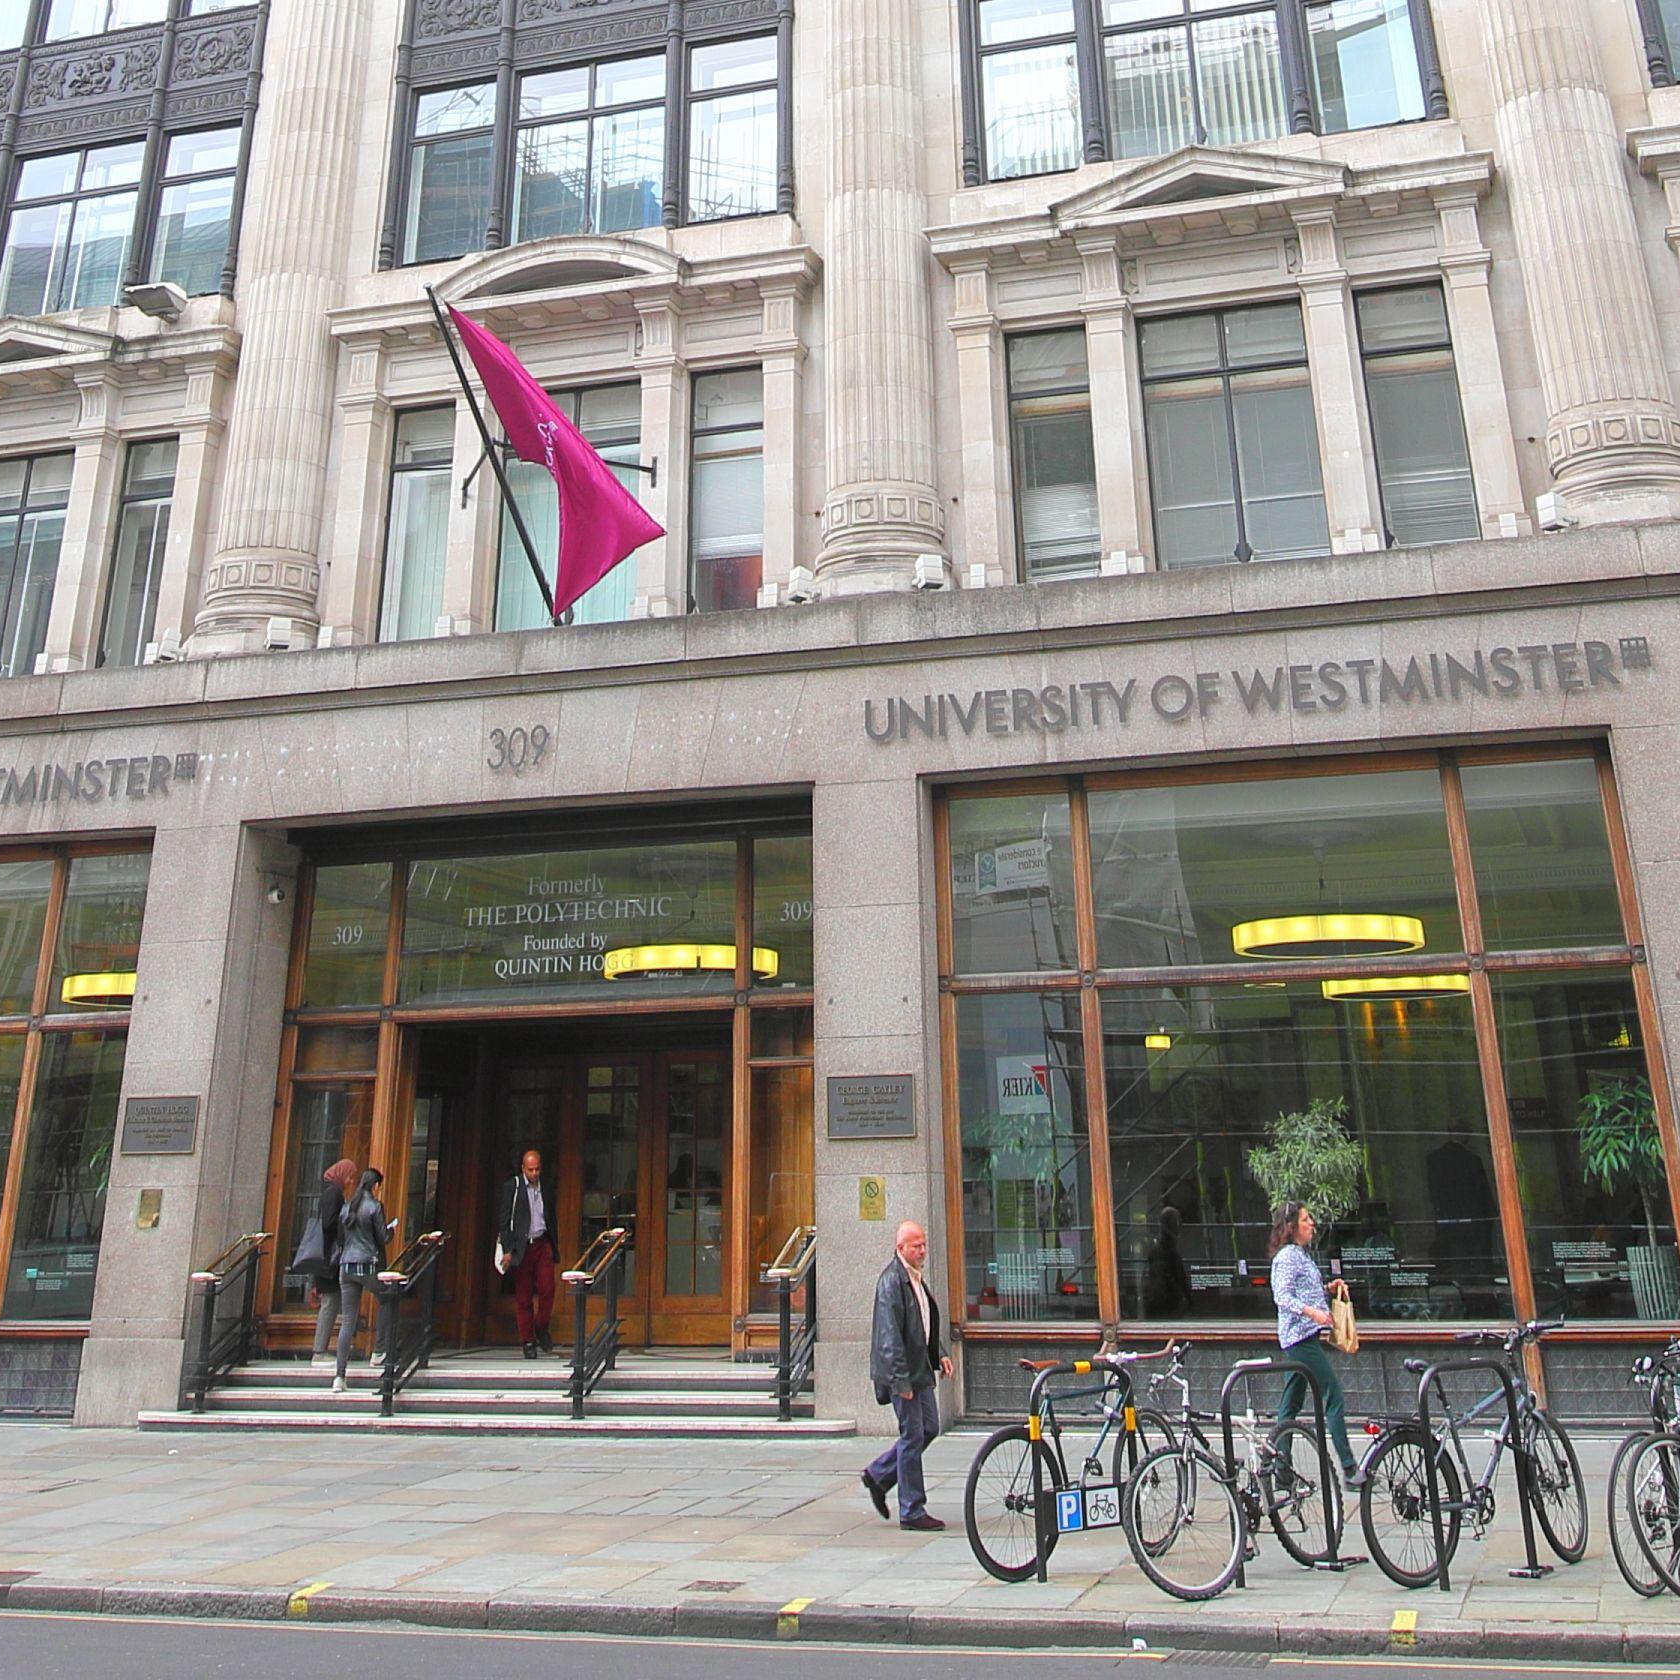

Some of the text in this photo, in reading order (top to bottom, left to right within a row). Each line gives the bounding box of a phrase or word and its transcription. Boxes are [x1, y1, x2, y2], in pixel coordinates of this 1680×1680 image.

[863, 638, 1619, 743] UNIVERSITY OF WESTMINSTER
[486, 724, 551, 770] 309
[528, 873, 608, 897] Formerly
[464, 897, 674, 928] THE POLYTECHNIC
[780, 900, 813, 922] 309
[332, 924, 363, 946] 309
[522, 932, 608, 952] Founded by
[494, 952, 635, 979] QUINTIN HOGG
[1061, 1495, 1077, 1528] P
